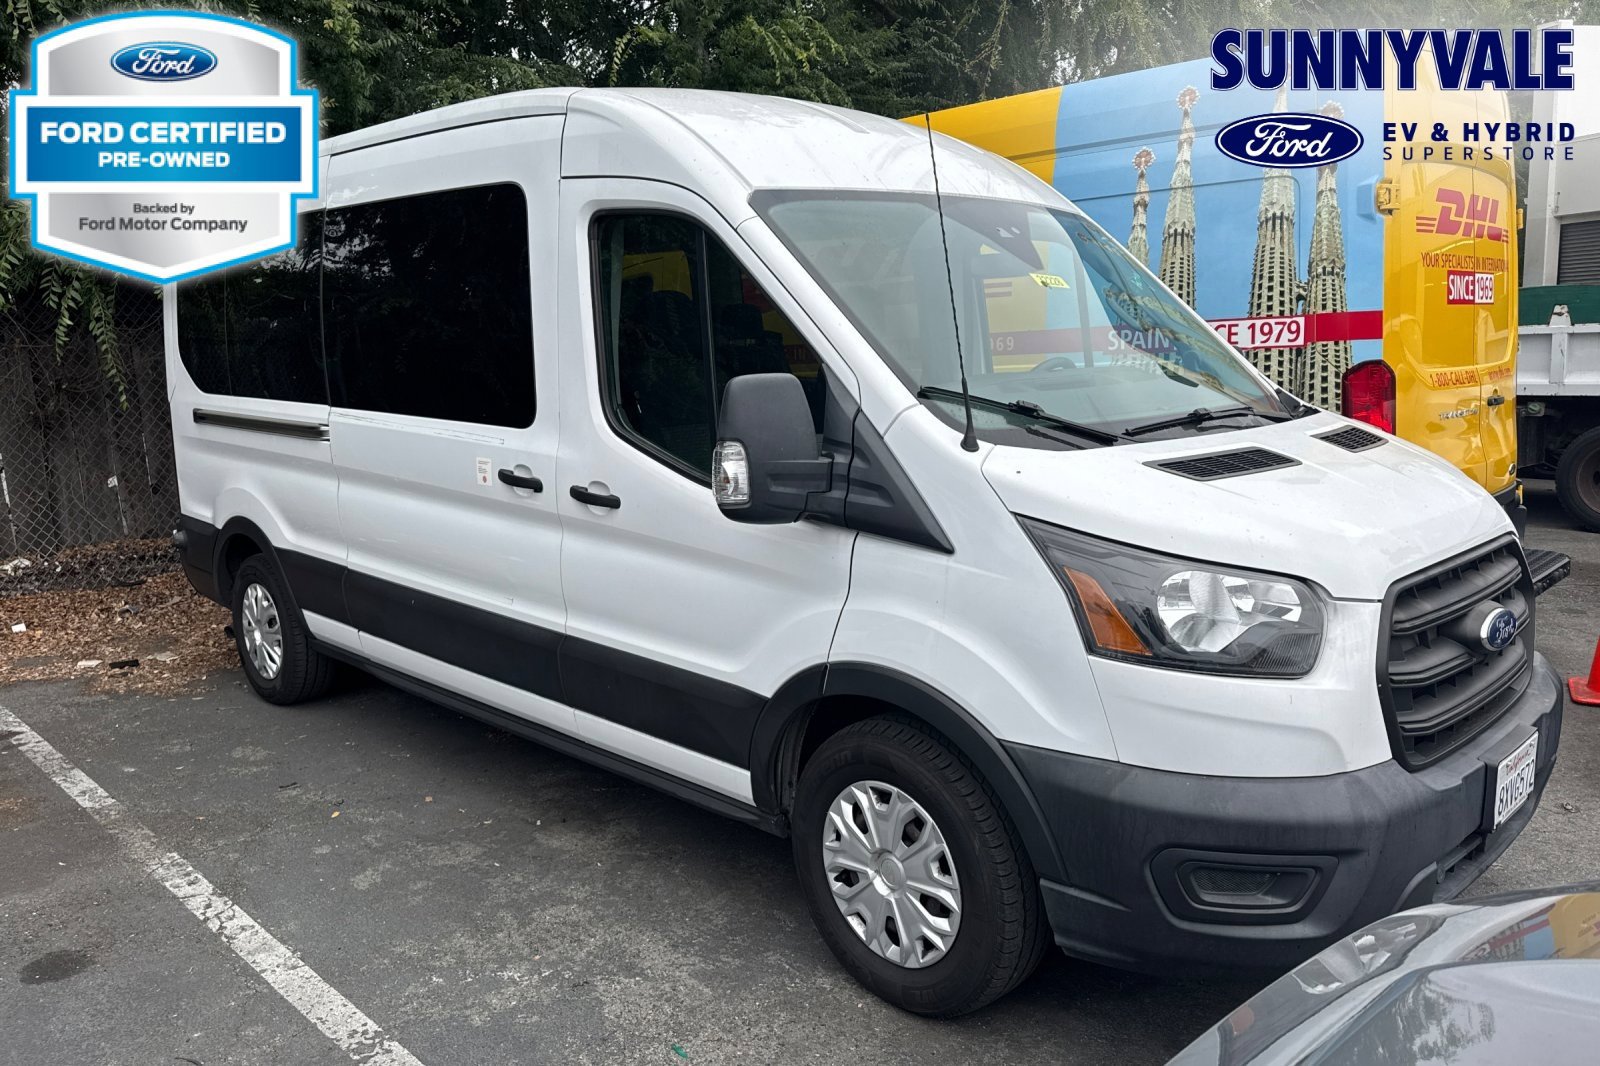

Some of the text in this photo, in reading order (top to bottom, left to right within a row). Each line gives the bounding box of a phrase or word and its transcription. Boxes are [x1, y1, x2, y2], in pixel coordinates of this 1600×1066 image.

[1435, 188, 1502, 242] DHL
[1421, 252, 1440, 268] YOUR
[1441, 253, 1474, 269] SPECIALISTS
[1449, 275, 1493, 300] SINCE 1969
[1108, 328, 1170, 350] SPAIN
[1247, 320, 1301, 345] 1979
[1498, 758, 1534, 816] 8XVG572
